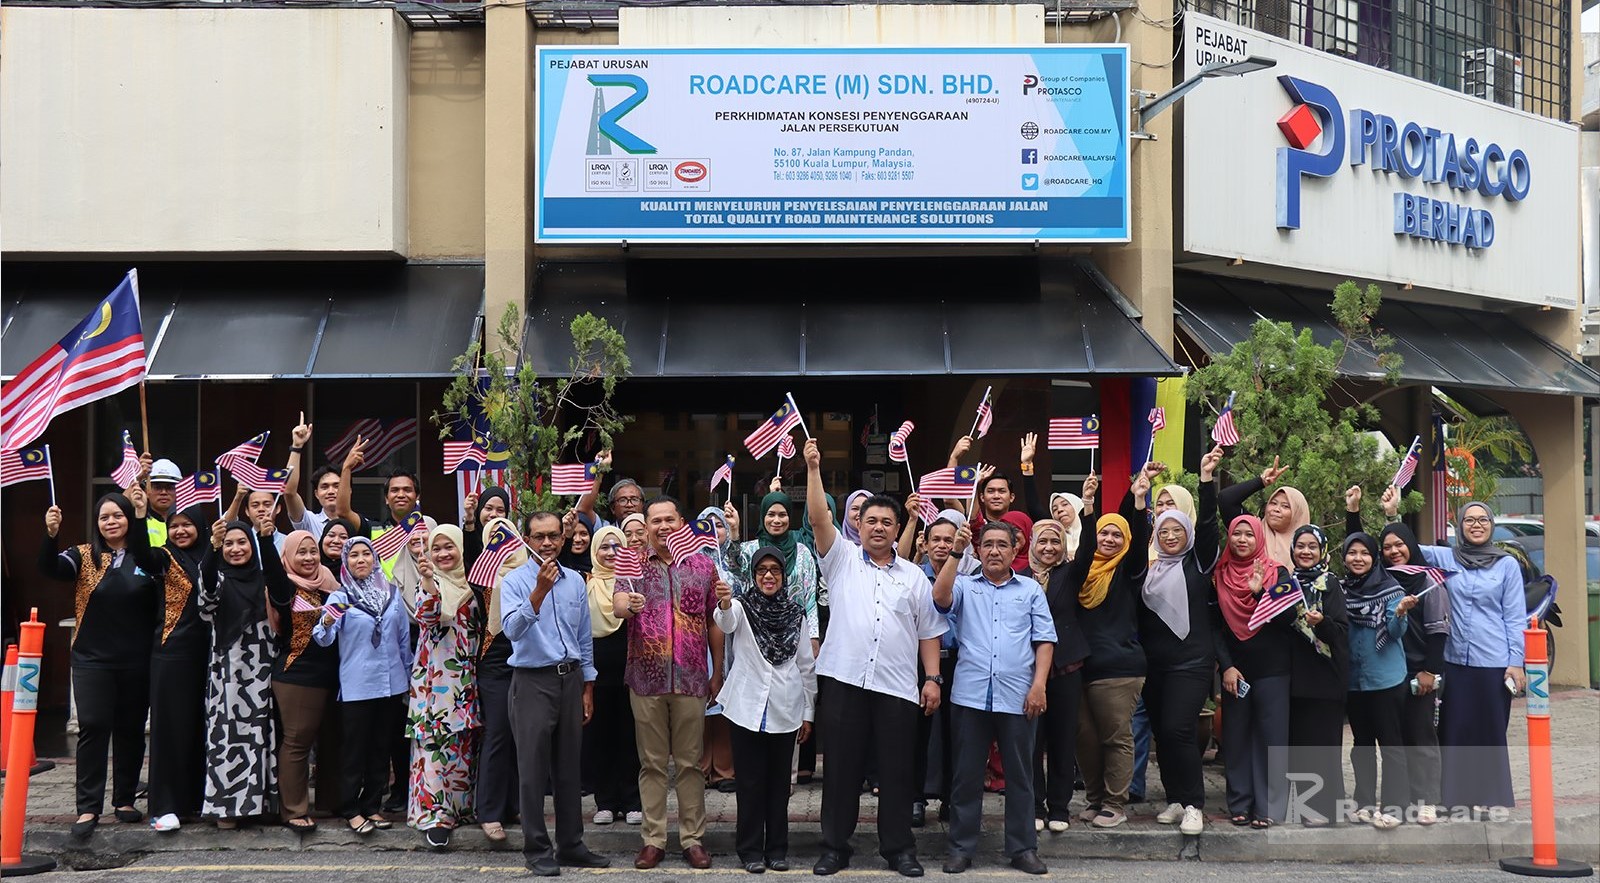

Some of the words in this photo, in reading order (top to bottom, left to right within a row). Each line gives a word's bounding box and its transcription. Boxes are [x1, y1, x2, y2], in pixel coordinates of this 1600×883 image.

[1196, 26, 1248, 56] PEJABAT
[550, 60, 599, 69] PEJABAT
[602, 60, 649, 69] URUSAN
[1196, 49, 1243, 75] URU
[689, 74, 827, 95] ROADCARE
[834, 74, 870, 99] (M)
[877, 74, 934, 95] SDN.
[942, 74, 1000, 95] BHD.
[1038, 87, 1082, 96] PROTASCO
[965, 97, 1000, 105] (490724-U)
[715, 110, 806, 121] PERKHIDMATAN
[809, 110, 860, 121] KONSESI
[863, 110, 969, 121] PENYENGGARAAN
[780, 123, 816, 133] JALAN
[818, 123, 899, 133] PERSEKUTUAN
[773, 147, 789, 157] No.
[791, 147, 805, 158] 87,
[807, 147, 831, 157] Jalan
[834, 147, 877, 159] Kampung
[879, 147, 915, 158] Pandan,
[1349, 108, 1531, 201] PROTASCO
[773, 158, 801, 168] 55100
[803, 158, 830, 168] Kuala
[832, 158, 870, 170] Lumpur,
[872, 158, 915, 170] Malaysia.
[861, 171, 877, 181] Faks:
[902, 171, 915, 181] 5507
[1043, 178, 1103, 186] @ROADCARE_HQ
[640, 201, 692, 211] KUALITI
[694, 201, 781, 211] MENYELURUH
[784, 201, 878, 211] PENYELESAIAN
[880, 201, 1006, 211] PENYELENGGARAAN
[1009, 201, 1049, 211] JALAN
[684, 214, 725, 224] TOTAL
[726, 214, 782, 225] QUALITY
[785, 214, 821, 224] ROAD
[824, 214, 917, 224] MAINTENANCE
[920, 214, 994, 224] SOLUTIONS
[1394, 192, 1495, 249] BERHAD
